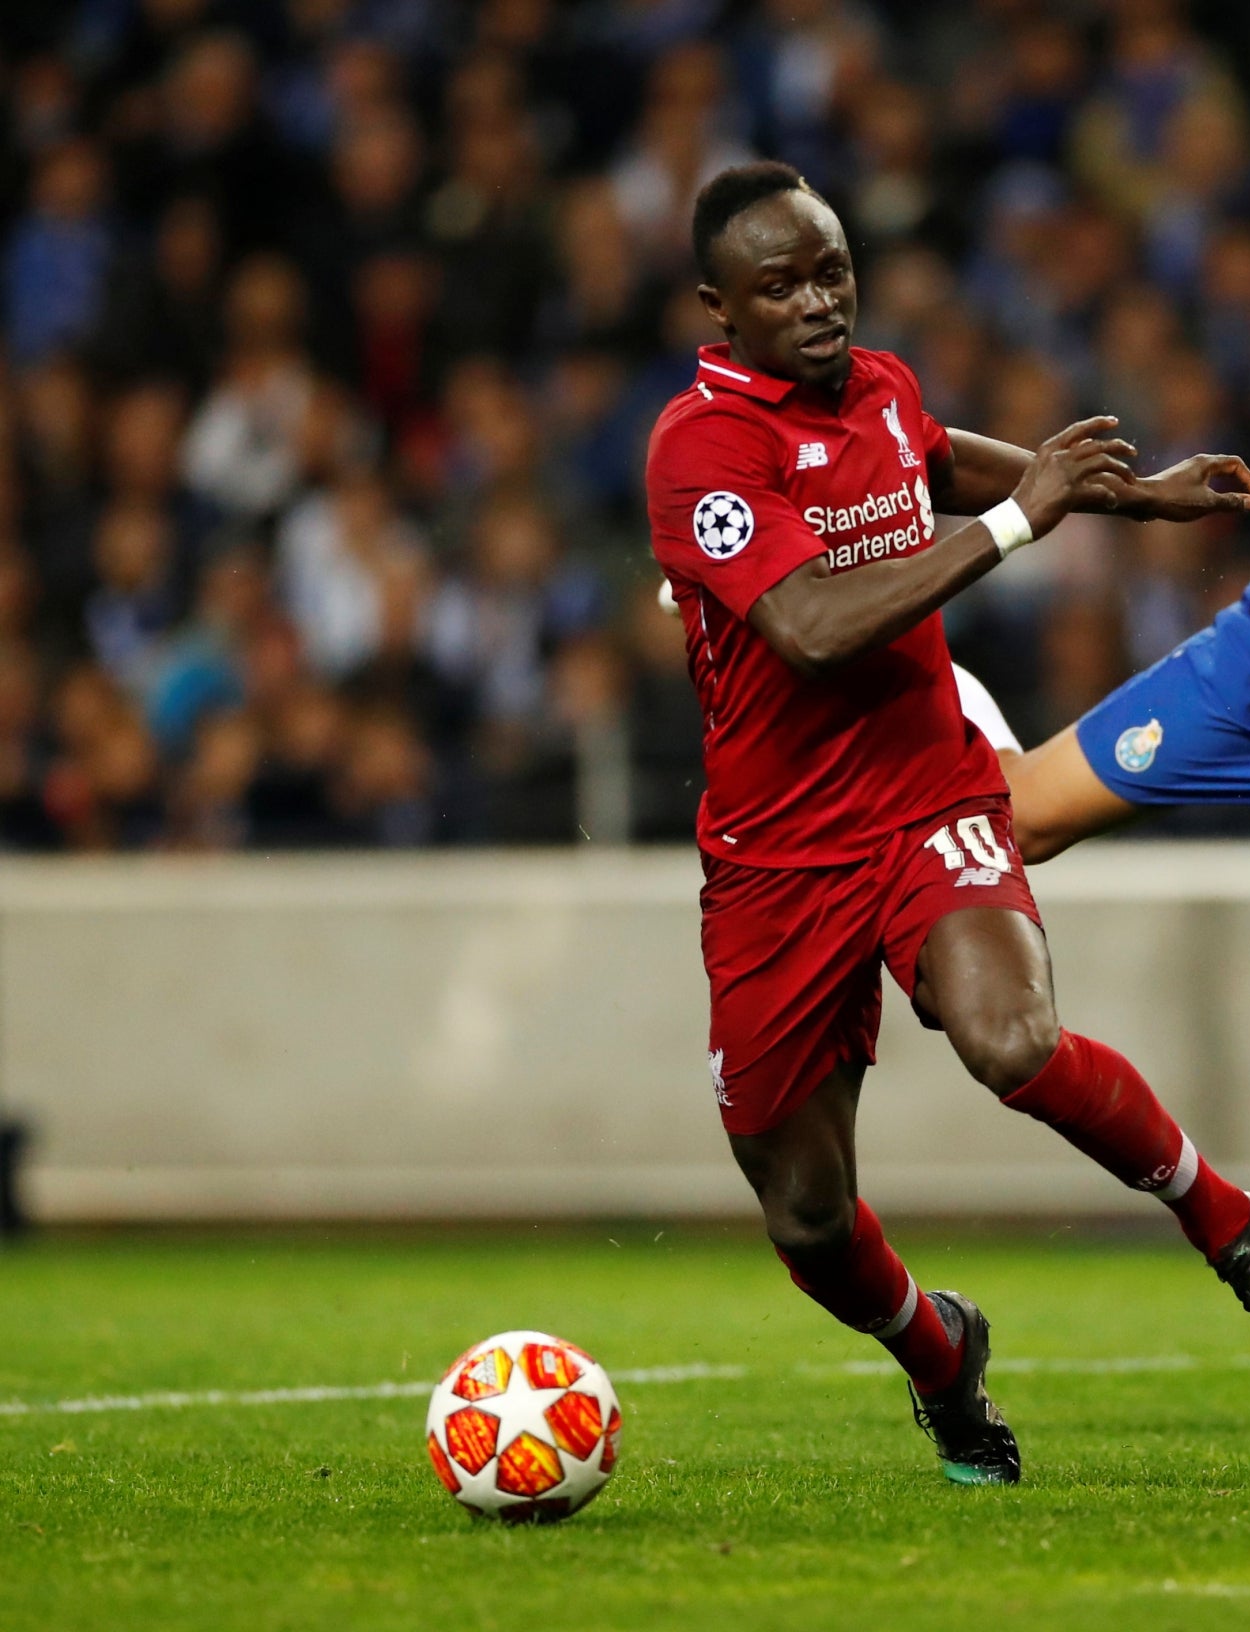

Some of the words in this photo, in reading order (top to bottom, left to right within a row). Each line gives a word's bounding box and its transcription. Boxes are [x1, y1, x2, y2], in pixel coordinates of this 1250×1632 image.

[803, 482, 914, 536] Standard
[828, 516, 920, 569] artered
[923, 814, 1012, 872] 10
